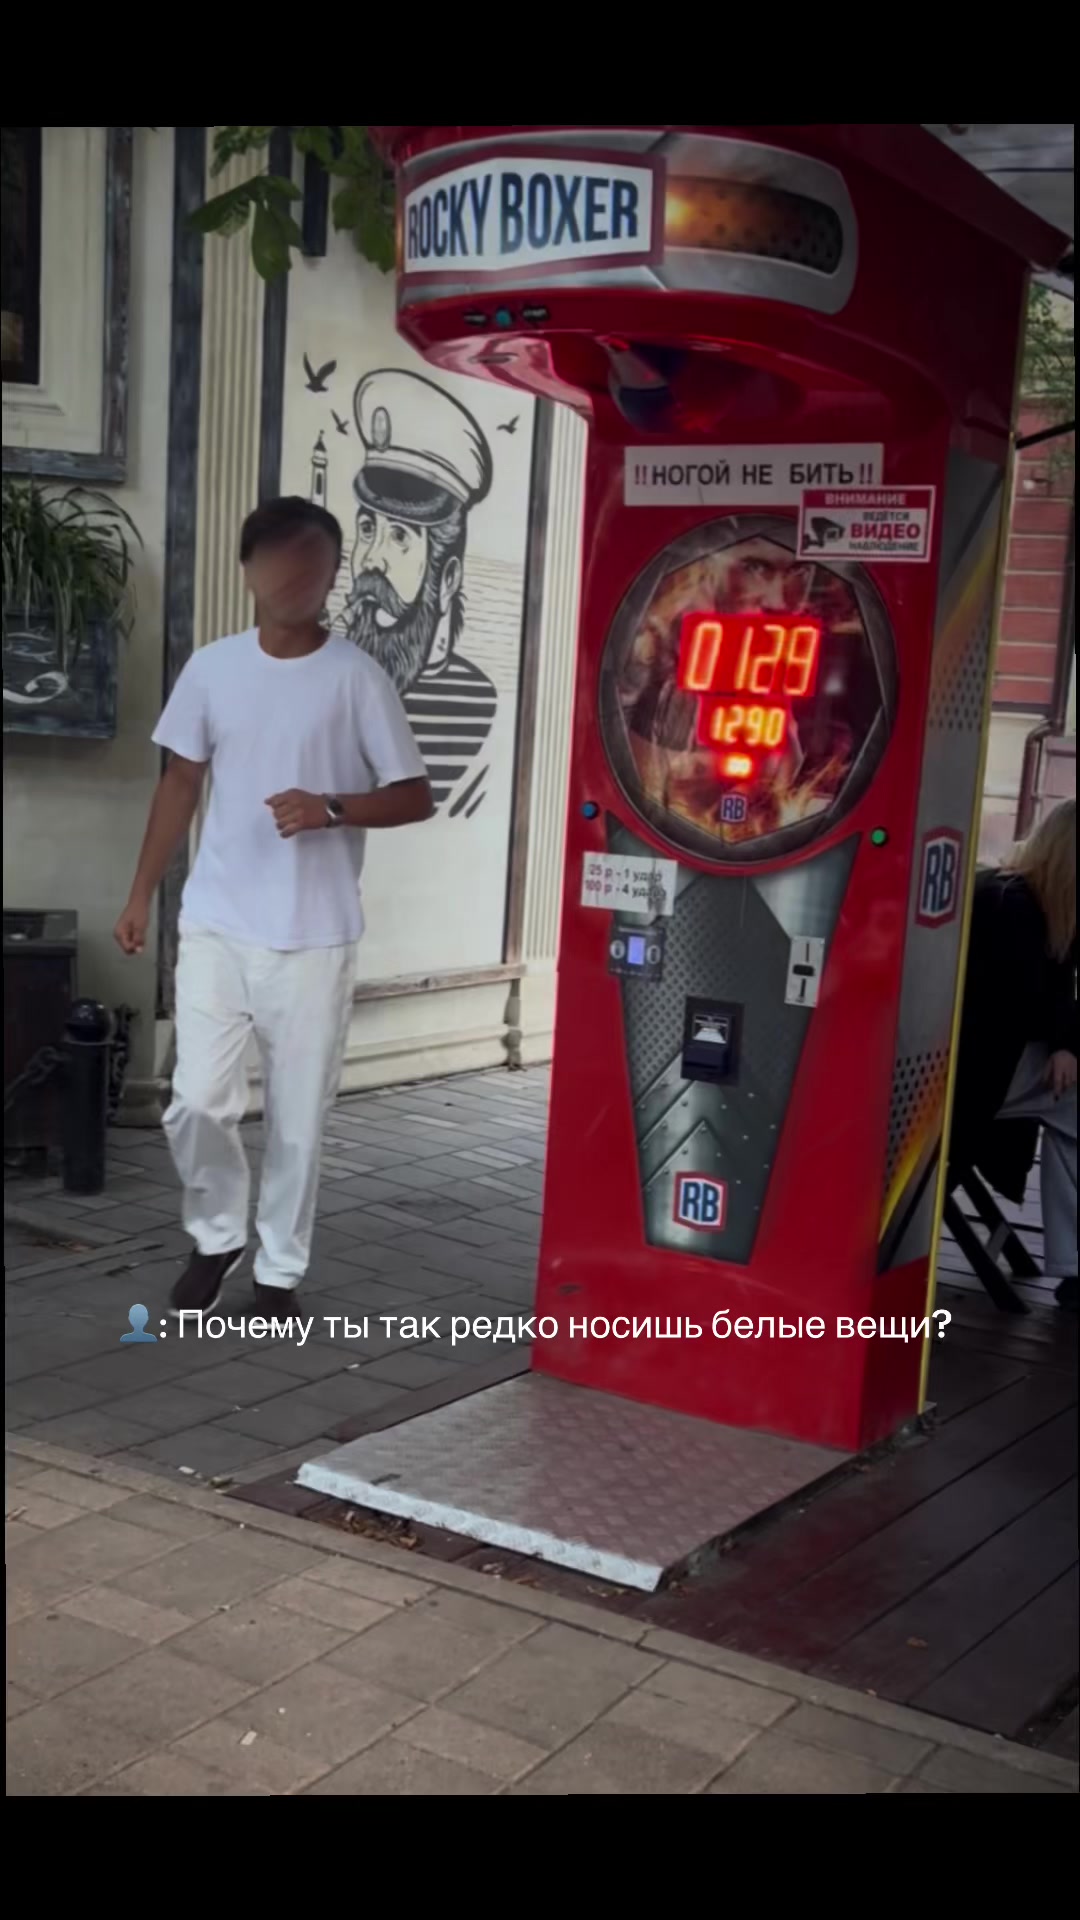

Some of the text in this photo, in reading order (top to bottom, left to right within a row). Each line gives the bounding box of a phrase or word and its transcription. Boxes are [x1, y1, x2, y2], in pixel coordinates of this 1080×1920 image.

[408, 171, 639, 259] ROCKY BOXER
[741, 463, 773, 485] НЕ
[824, 492, 907, 506] ВНИМАНИЕ
[849, 522, 921, 541] ВИДЕО
[848, 541, 920, 552] НАБЛЮДЕНИЕ
[685, 621, 821, 696] 0129
[710, 704, 786, 747] 1290
[723, 796, 745, 820] RB
[622, 883, 630, 895] 4
[922, 842, 957, 913] RB
[682, 1181, 719, 1223] RB
